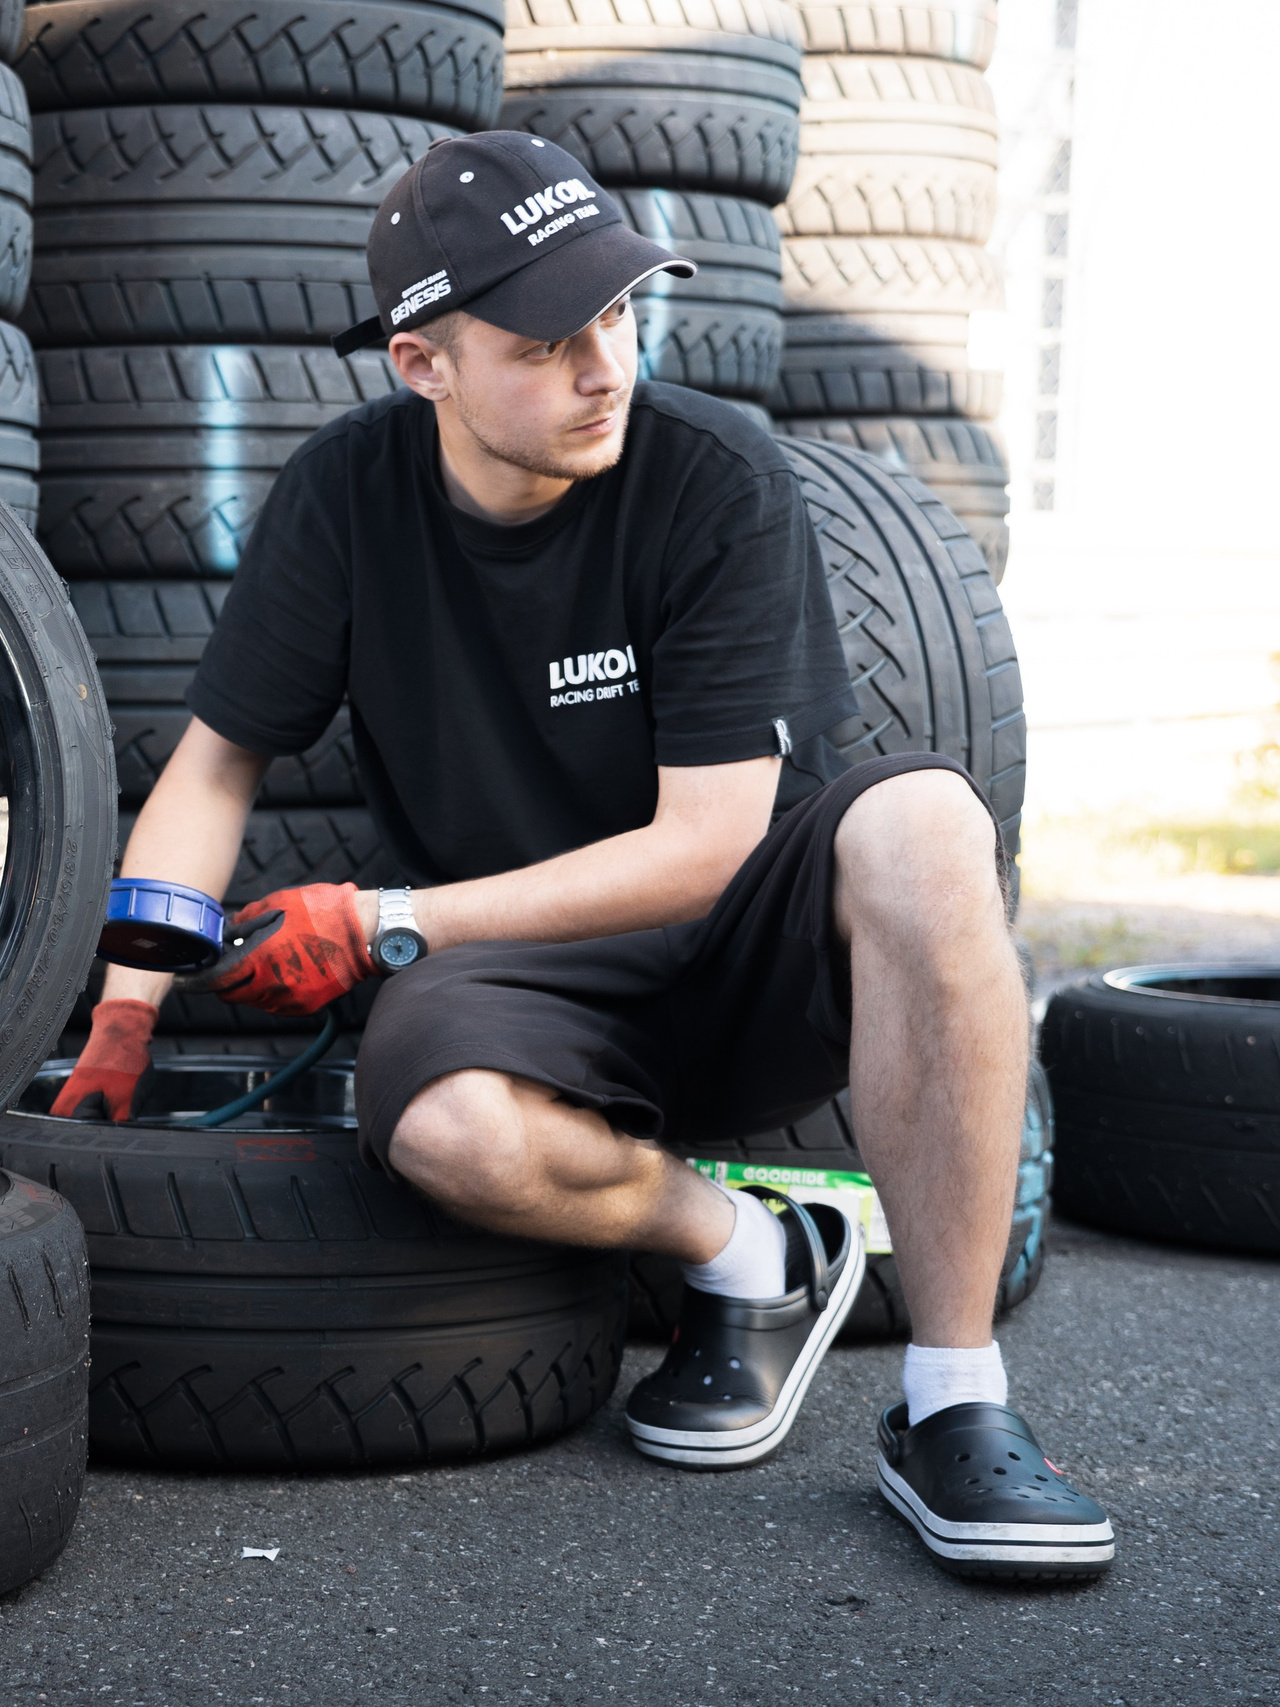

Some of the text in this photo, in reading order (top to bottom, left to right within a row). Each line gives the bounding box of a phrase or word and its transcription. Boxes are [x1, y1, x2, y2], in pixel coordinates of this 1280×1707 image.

[499, 178, 597, 236] LUKOIL
[526, 211, 576, 247] RACING
[390, 278, 452, 326] GENESIS
[549, 644, 637, 690] LUKOI
[550, 679, 640, 708] RACING DRIFT TE
[30, 1007, 47, 1029] FOR
[742, 1166, 827, 1186] GOODRIDE
